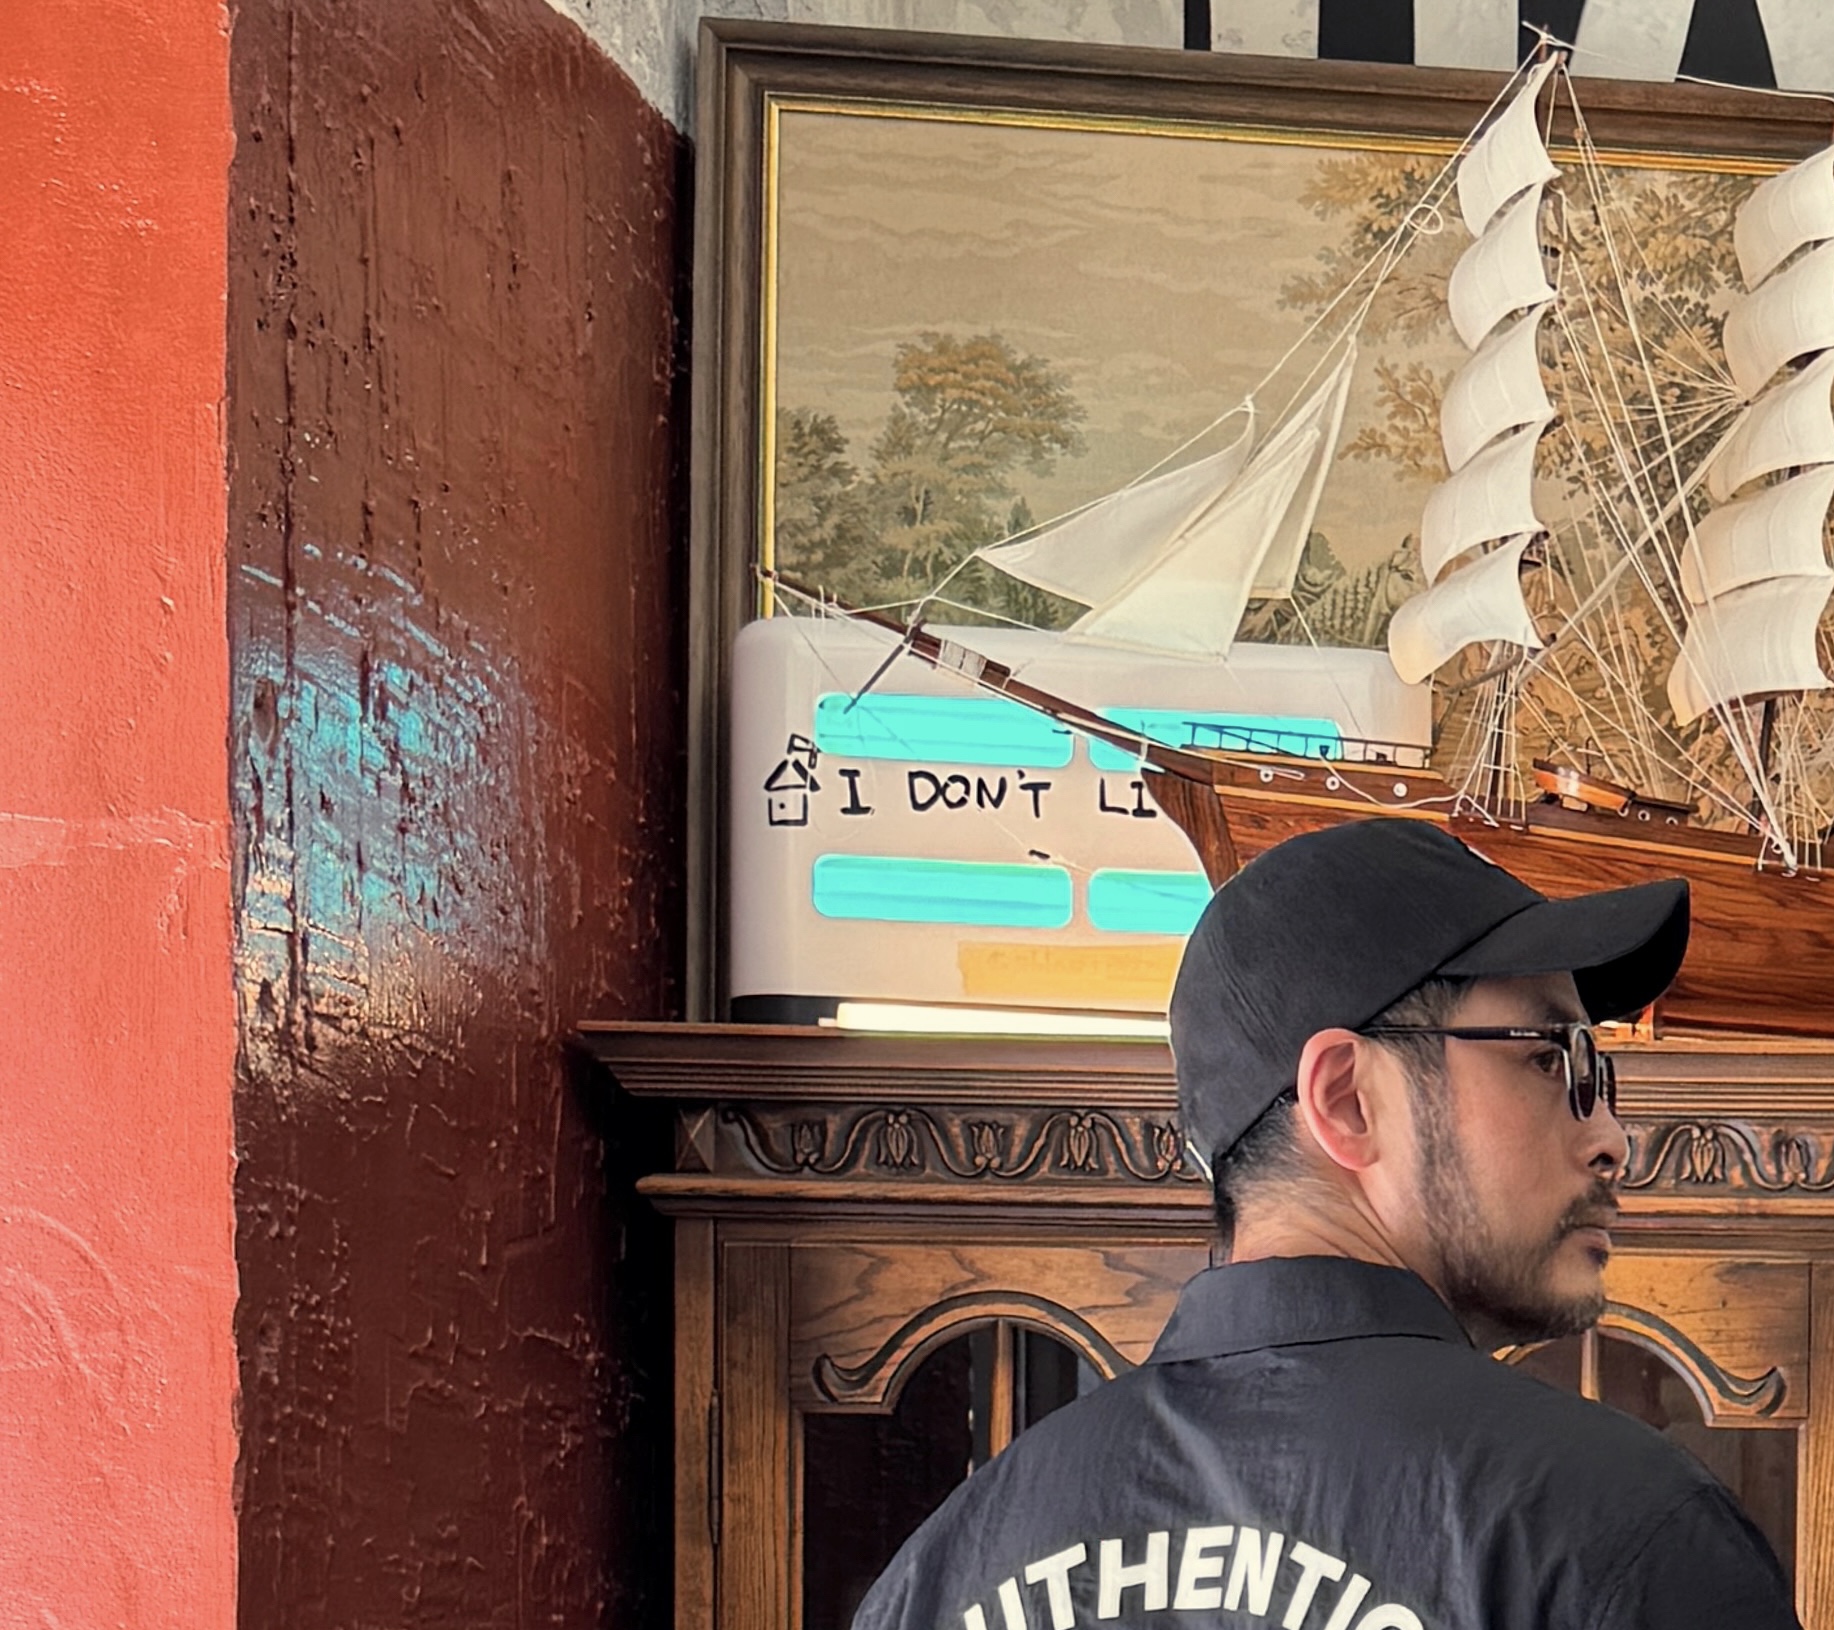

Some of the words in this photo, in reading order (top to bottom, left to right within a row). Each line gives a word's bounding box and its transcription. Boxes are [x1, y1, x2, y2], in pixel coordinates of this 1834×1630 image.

[838, 768, 875, 817] I
[907, 769, 1052, 819] DON'T
[1098, 777, 1158, 818] LI
